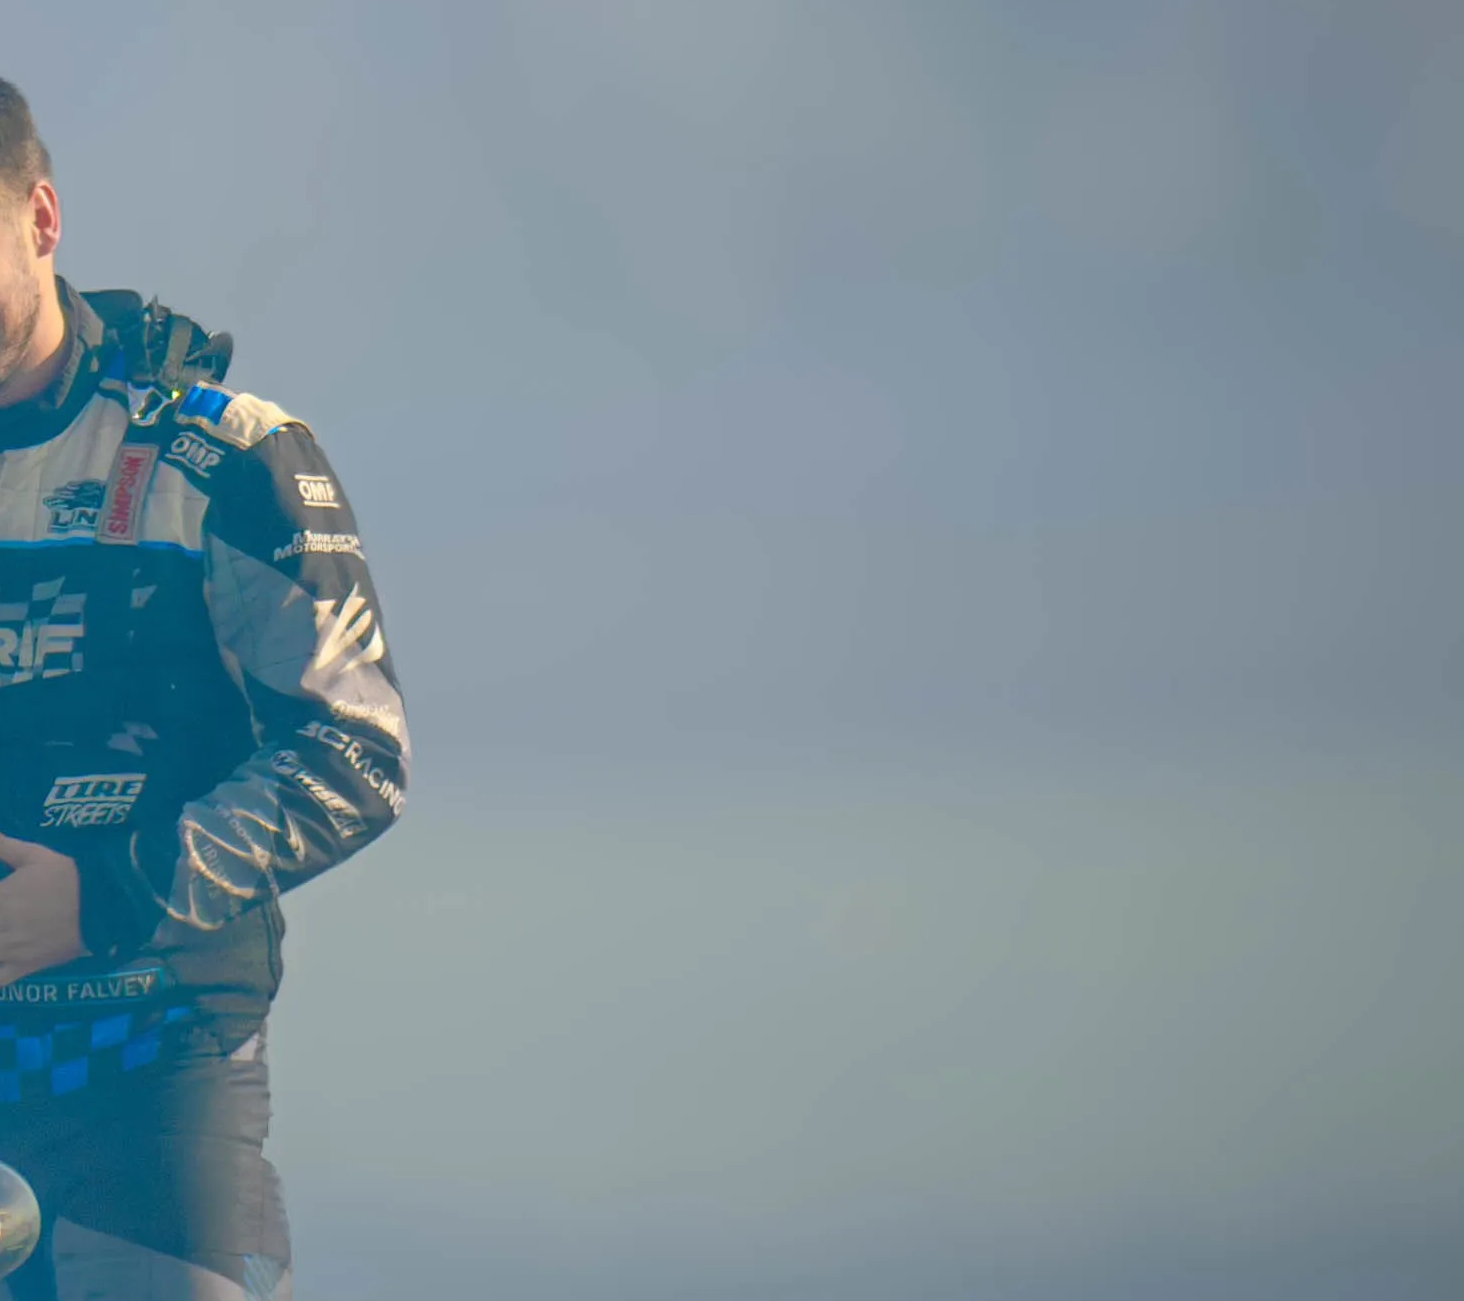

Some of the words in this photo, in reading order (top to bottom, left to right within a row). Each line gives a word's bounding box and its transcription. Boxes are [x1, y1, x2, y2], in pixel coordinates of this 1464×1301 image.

[171, 437, 220, 469] OMP
[107, 454, 144, 535] SIMPSON
[40, 803, 132, 828] STREETS
[67, 974, 154, 1001] FALVEY
